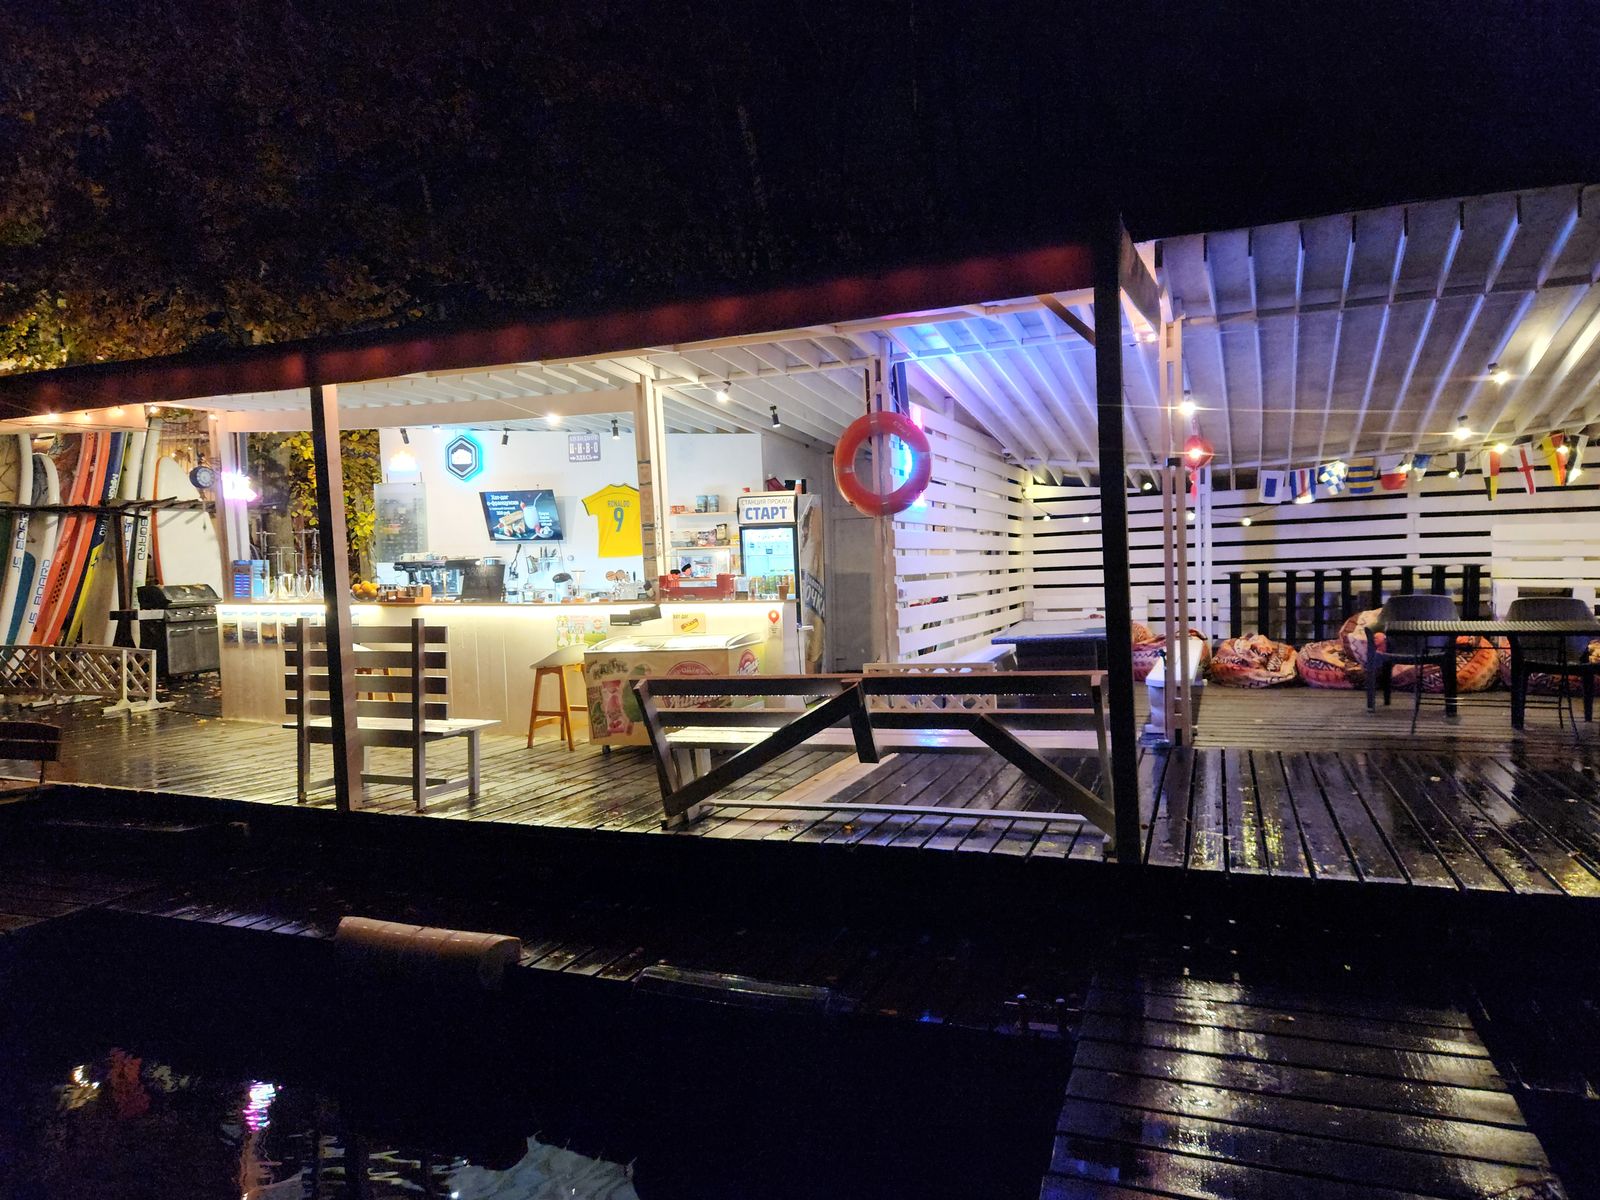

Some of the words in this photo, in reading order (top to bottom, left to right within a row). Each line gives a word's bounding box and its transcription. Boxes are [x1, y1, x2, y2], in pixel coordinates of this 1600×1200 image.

[613, 507, 624, 533] 9
[745, 506, 787, 520] СТАРТ
[13, 556, 21, 573] JS
[29, 612, 38, 625] JS
[34, 559, 50, 606] BOARD
